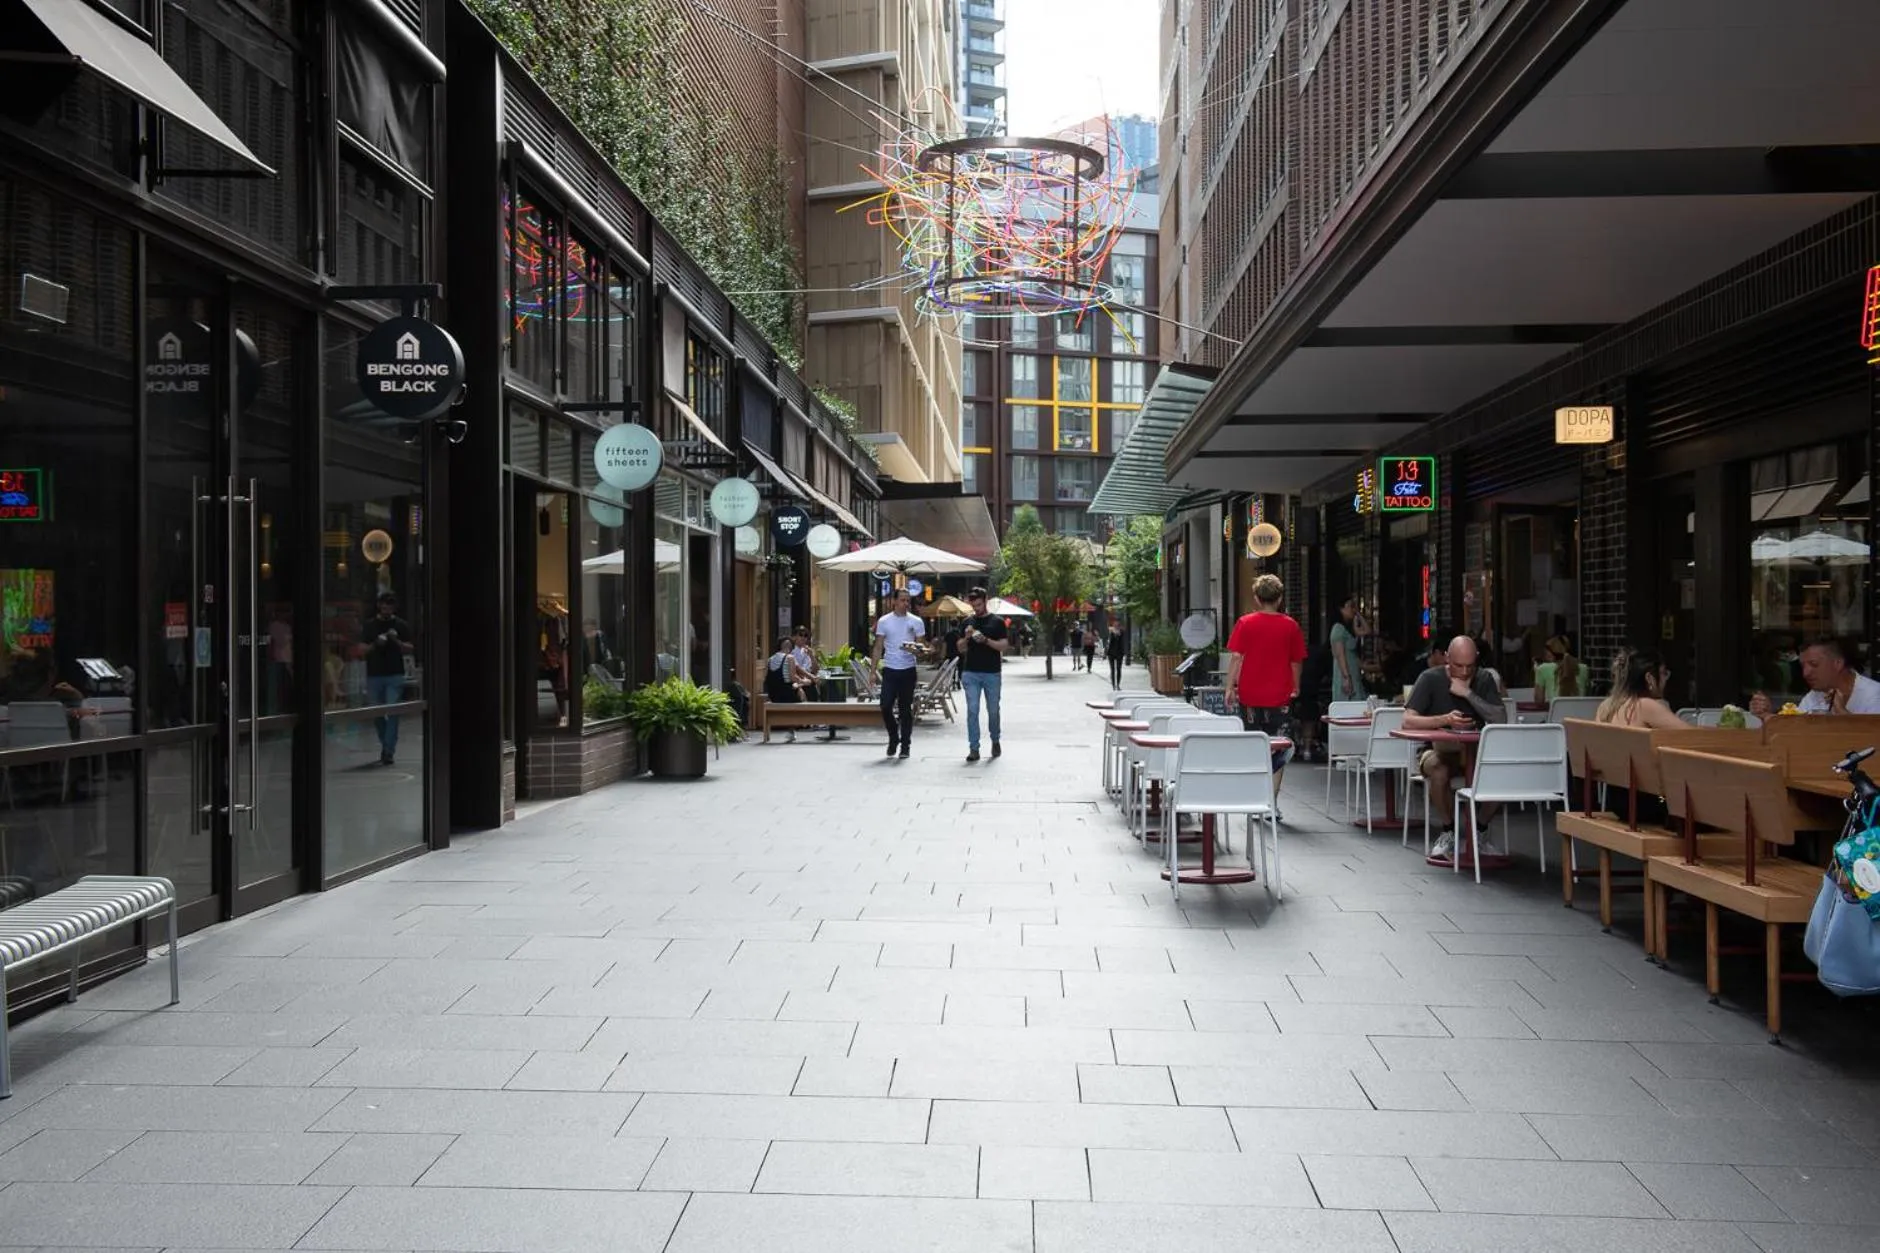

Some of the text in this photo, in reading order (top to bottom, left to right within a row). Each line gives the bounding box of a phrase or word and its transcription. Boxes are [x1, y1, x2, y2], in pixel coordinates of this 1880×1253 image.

[366, 363, 450, 376] BENGONG
[380, 380, 437, 392] BLACK
[1567, 409, 1611, 426] DOPA
[606, 446, 649, 456] fifteen
[607, 458, 648, 467] sheets
[1397, 460, 1420, 481] 13
[1384, 495, 1432, 508] TATTOO
[778, 515, 802, 524] SHORT
[780, 523, 800, 531] STOP
